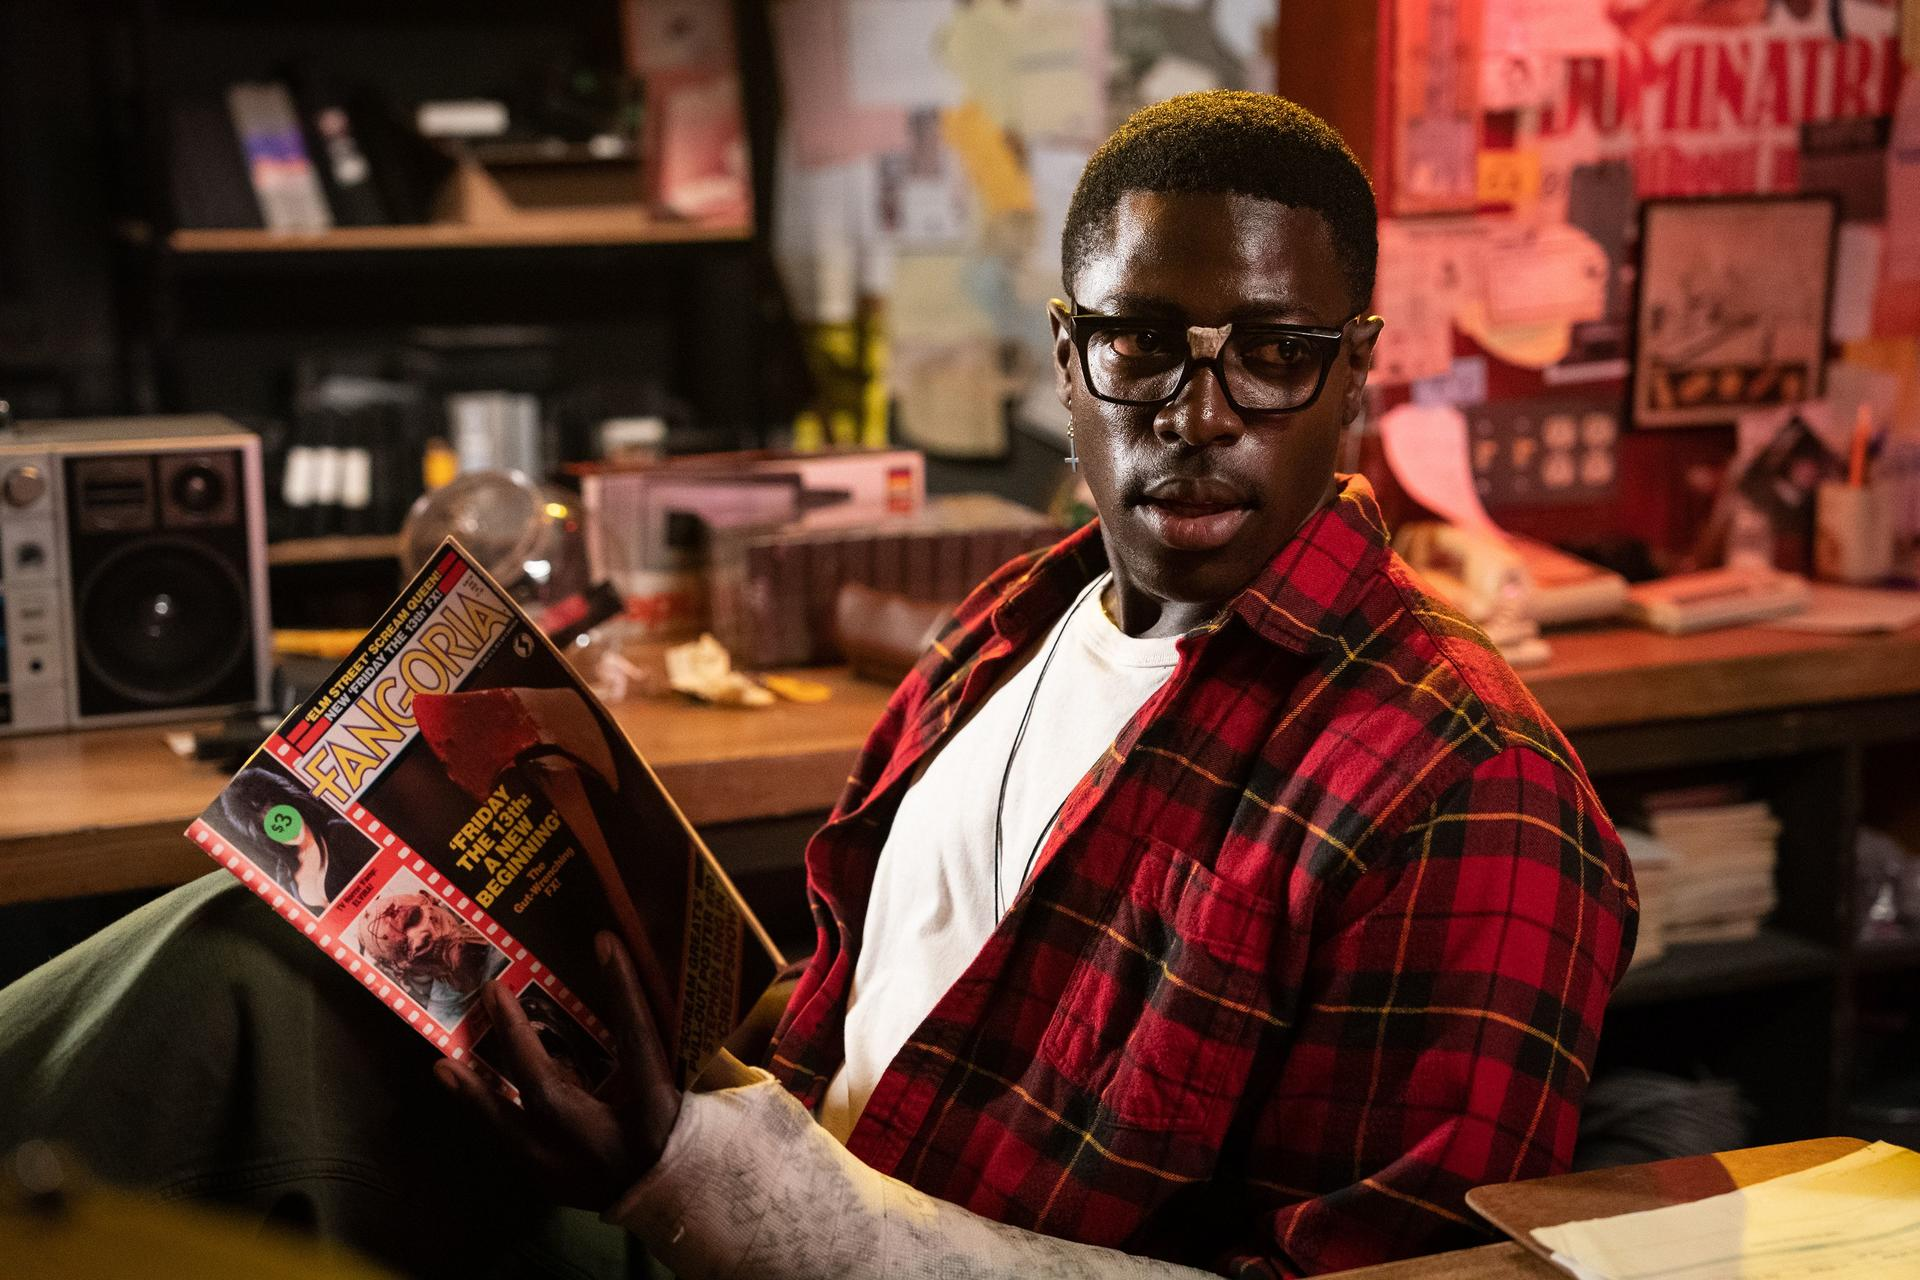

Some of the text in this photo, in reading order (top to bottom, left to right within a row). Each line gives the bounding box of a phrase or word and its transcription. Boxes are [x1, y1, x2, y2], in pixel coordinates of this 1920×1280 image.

[366, 606, 410, 654] SCREAM
[405, 570, 442, 611] QUEEN!
[323, 692, 351, 722] NEW
[382, 628, 407, 656] THE
[423, 588, 443, 609] FX!
[301, 591, 513, 806] FANGORIA
[272, 813, 292, 833] $3
[455, 793, 533, 875] THE 13th:
[484, 814, 536, 875] A NEW
[336, 901, 345, 911] TV
[344, 884, 361, 903] Horror
[351, 882, 374, 908] ELVIRA!
[511, 844, 577, 915] Gut-Wrenching
[527, 861, 547, 880] The
[543, 877, 562, 897] FX!
[697, 909, 715, 982] POSTER
[702, 965, 723, 1053] STEPHEN
[713, 915, 727, 963] KING
